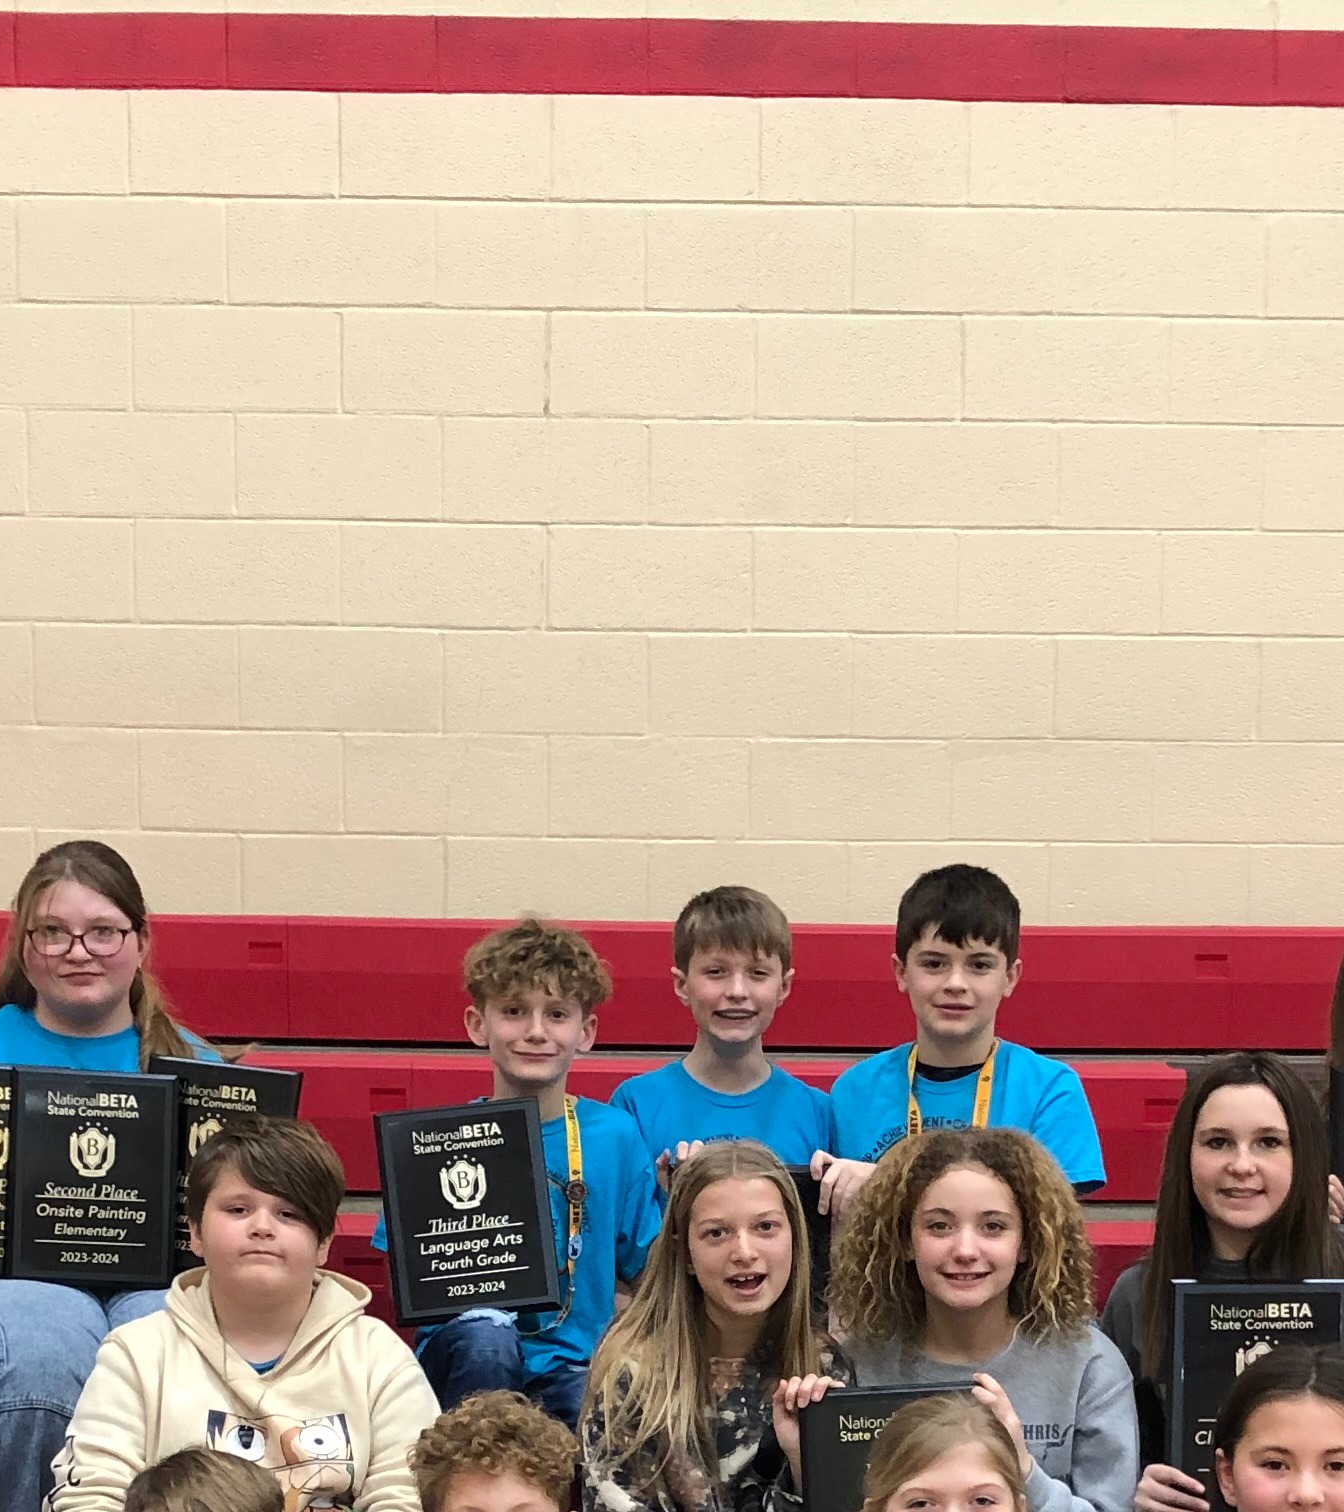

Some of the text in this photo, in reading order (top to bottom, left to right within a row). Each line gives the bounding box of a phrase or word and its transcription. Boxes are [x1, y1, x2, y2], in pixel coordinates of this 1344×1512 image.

[48, 1091, 138, 1108] NationalBETA
[201, 1097, 256, 1112] Convention
[48, 1106, 139, 1119] State Convention
[412, 1122, 501, 1145] NationalBETA
[414, 1137, 504, 1155] State Convention
[45, 1182, 138, 1200] Second Place
[36, 1204, 146, 1223] Onsite Painting
[54, 1223, 127, 1240] Elementary
[428, 1214, 509, 1234] Third Place
[420, 1232, 523, 1256] Language Arts
[60, 1252, 119, 1264] 2023-2024
[431, 1251, 516, 1271] Fourth Grade
[447, 1281, 505, 1297] 2023-2024
[1211, 1303, 1312, 1318] NationalBETA
[1211, 1319, 1313, 1331] State Convention
[840, 1431, 870, 1442] State
